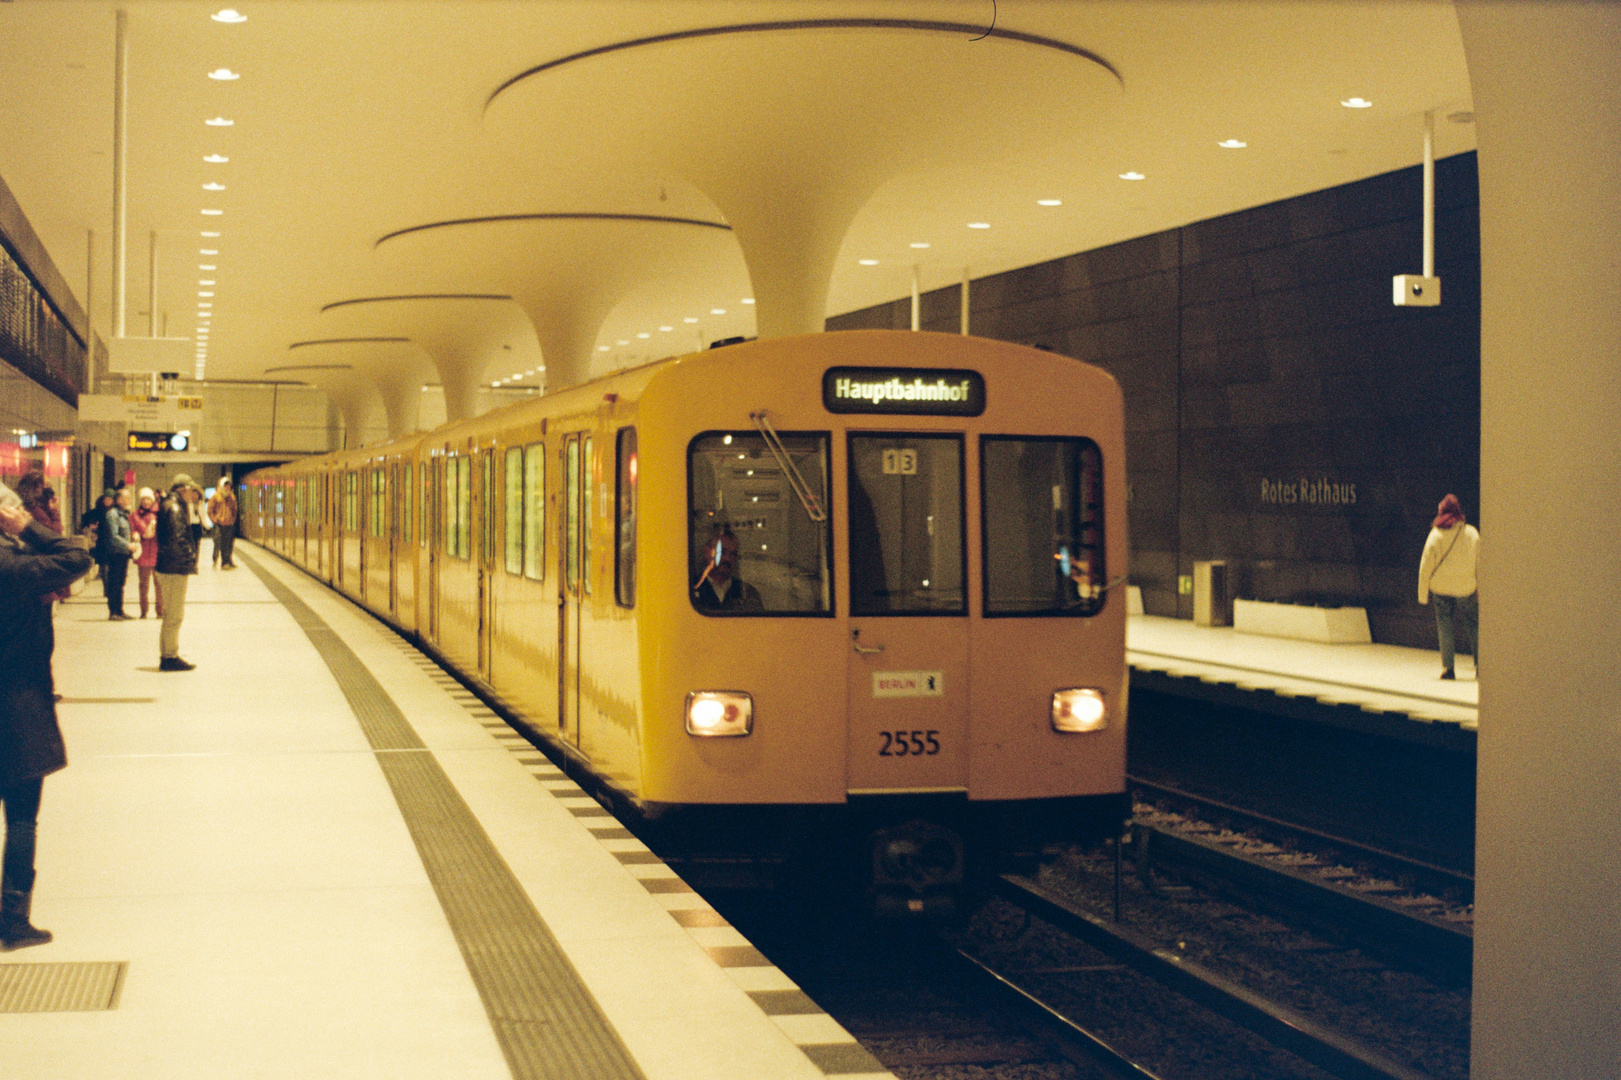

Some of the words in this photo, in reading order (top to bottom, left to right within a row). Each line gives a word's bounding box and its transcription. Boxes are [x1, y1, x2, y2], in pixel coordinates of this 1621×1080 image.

[836, 378, 969, 404] Hauptbahnhof
[888, 454, 913, 471] 13
[1261, 477, 1297, 503] Rotes
[1301, 476, 1356, 503] Rathaus
[878, 679, 916, 690] BERLIN
[879, 730, 940, 756] 2555
